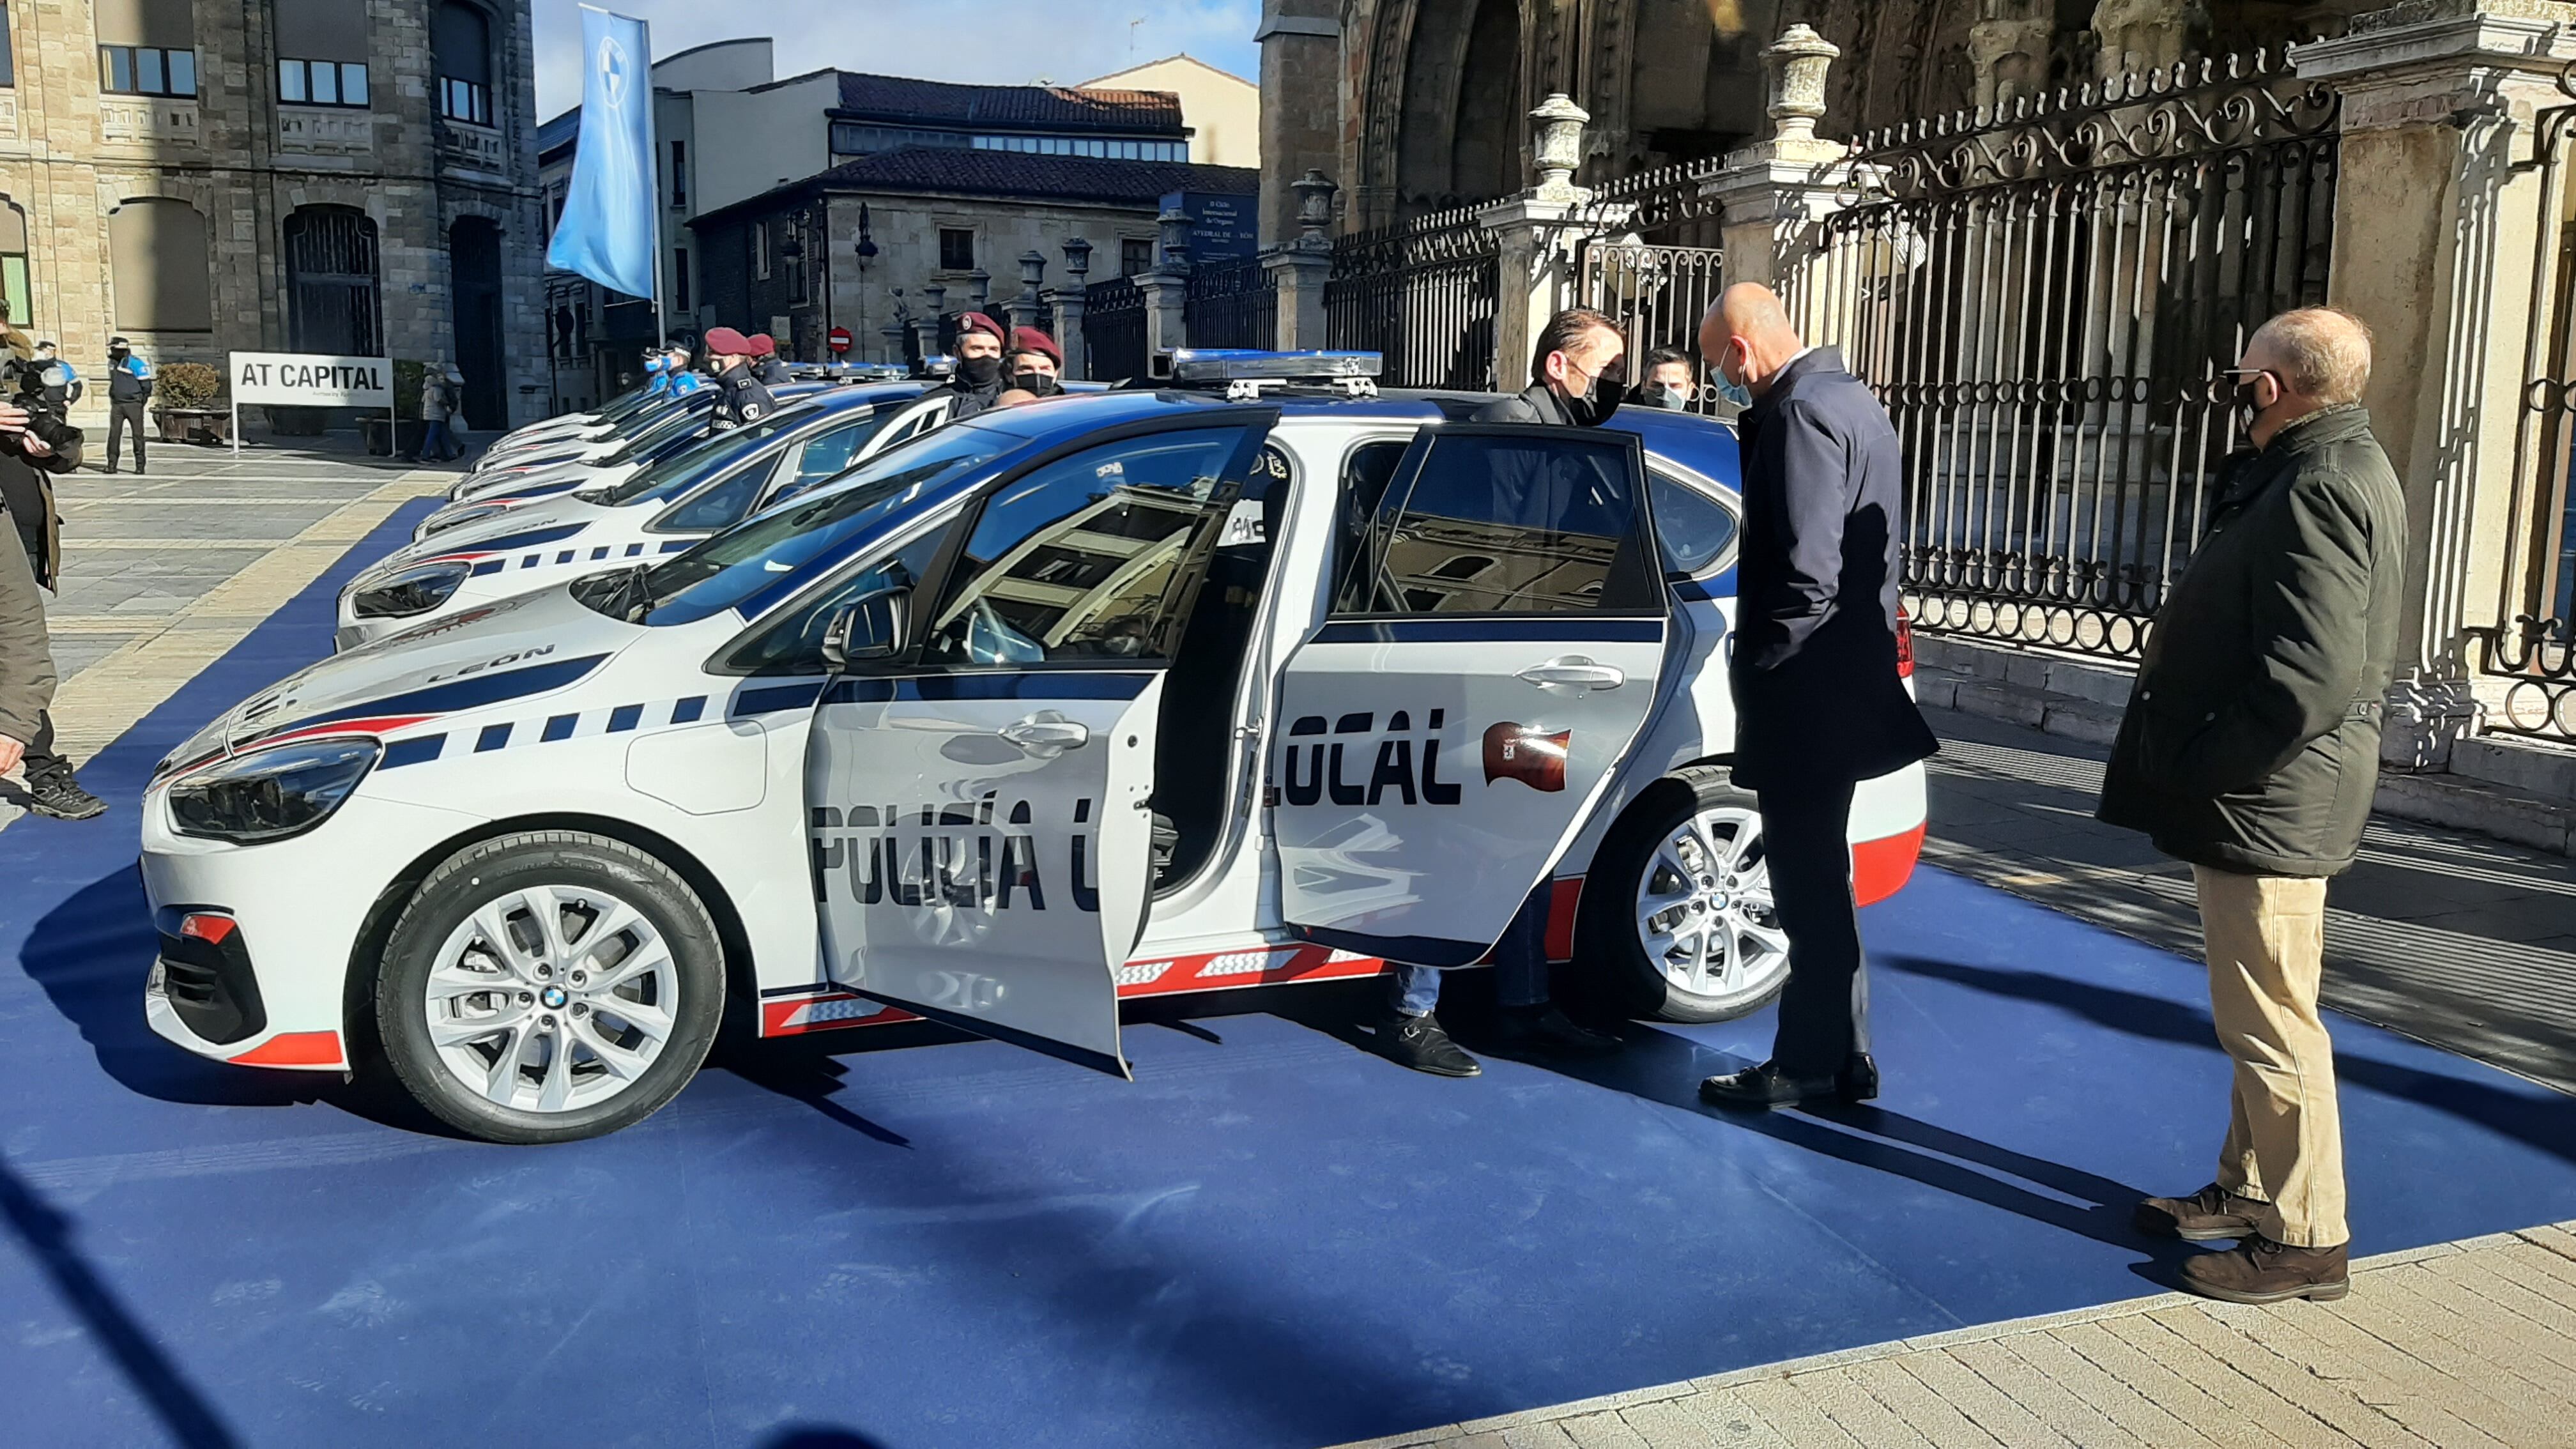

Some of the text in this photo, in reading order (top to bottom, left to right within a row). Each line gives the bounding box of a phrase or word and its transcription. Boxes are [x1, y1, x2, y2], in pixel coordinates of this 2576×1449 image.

[241, 363, 385, 390] AT CAPITAL
[1273, 707, 1462, 806] OCAL
[811, 789, 1046, 910] POLICÍA
